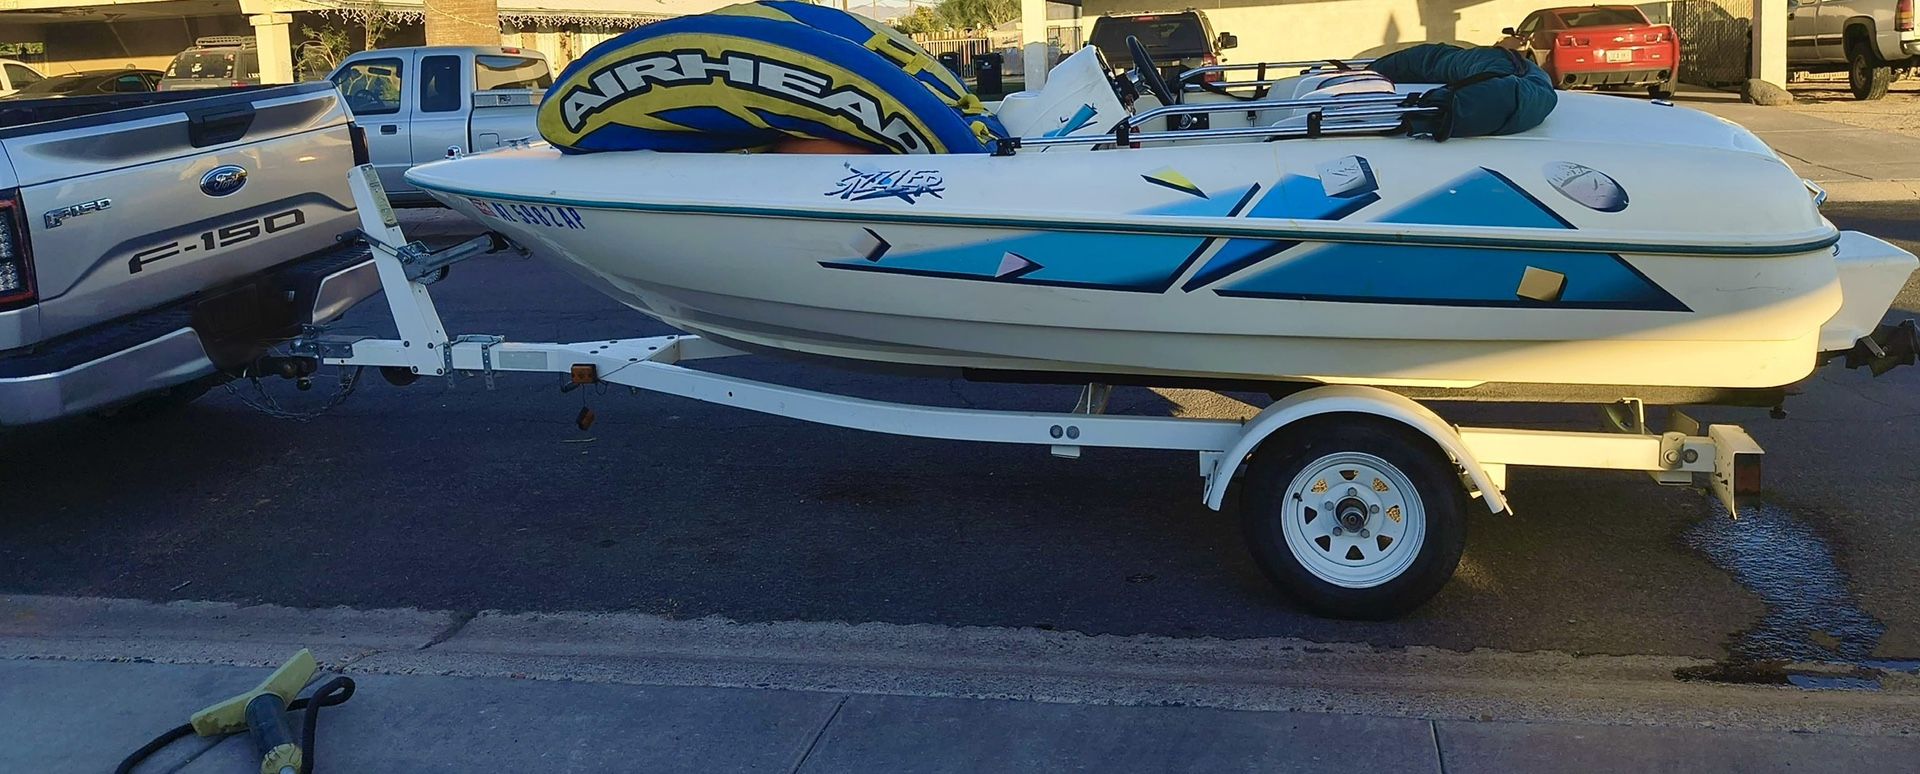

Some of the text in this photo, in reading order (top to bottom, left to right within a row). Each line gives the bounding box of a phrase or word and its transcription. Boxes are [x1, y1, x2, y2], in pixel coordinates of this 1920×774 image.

[561, 50, 932, 153] AIRHEAD
[128, 208, 306, 274] F-150
[491, 202, 518, 222] AZ
[556, 206, 586, 230] AP
